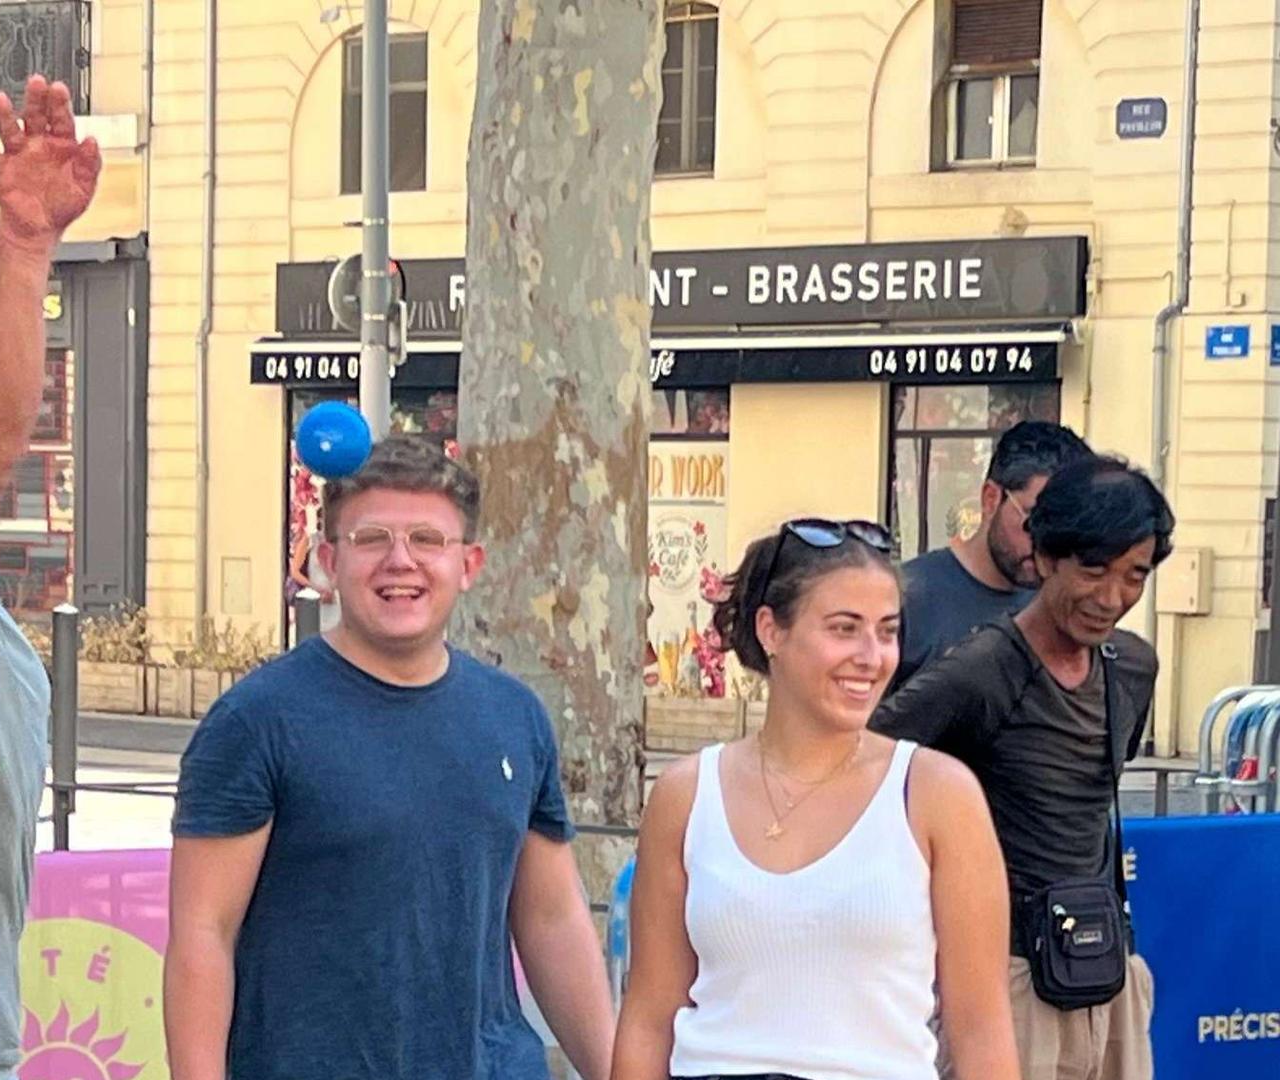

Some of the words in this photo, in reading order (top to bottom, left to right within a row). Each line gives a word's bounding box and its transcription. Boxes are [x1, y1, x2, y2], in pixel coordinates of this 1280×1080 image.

[748, 258, 982, 304] BRASSERIE
[266, 356, 287, 379] 04
[294, 356, 312, 379] 91
[318, 356, 340, 379] 04
[870, 349, 897, 374] 04
[905, 348, 926, 374] 91
[935, 348, 962, 373] 04
[970, 348, 998, 373] 07
[1006, 347, 1032, 372] 94
